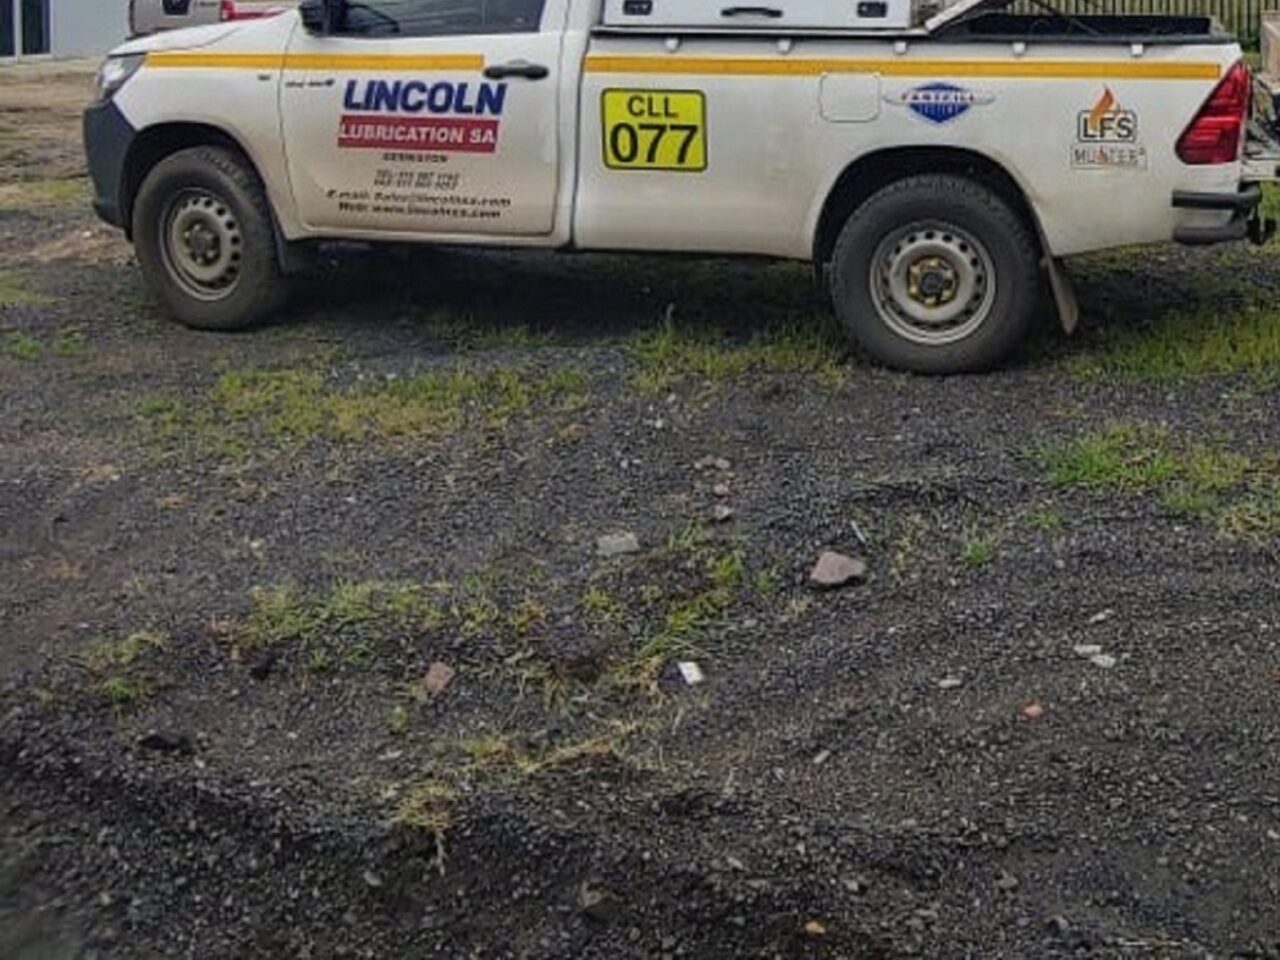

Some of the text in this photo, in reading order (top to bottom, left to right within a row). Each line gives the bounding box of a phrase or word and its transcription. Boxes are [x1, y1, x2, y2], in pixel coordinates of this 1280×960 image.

[343, 80, 507, 115] LINCOLN
[627, 95, 679, 117] CLL
[339, 123, 495, 144] LUBRICATION SA
[1083, 117, 1133, 138] LFS
[610, 122, 698, 164] 077
